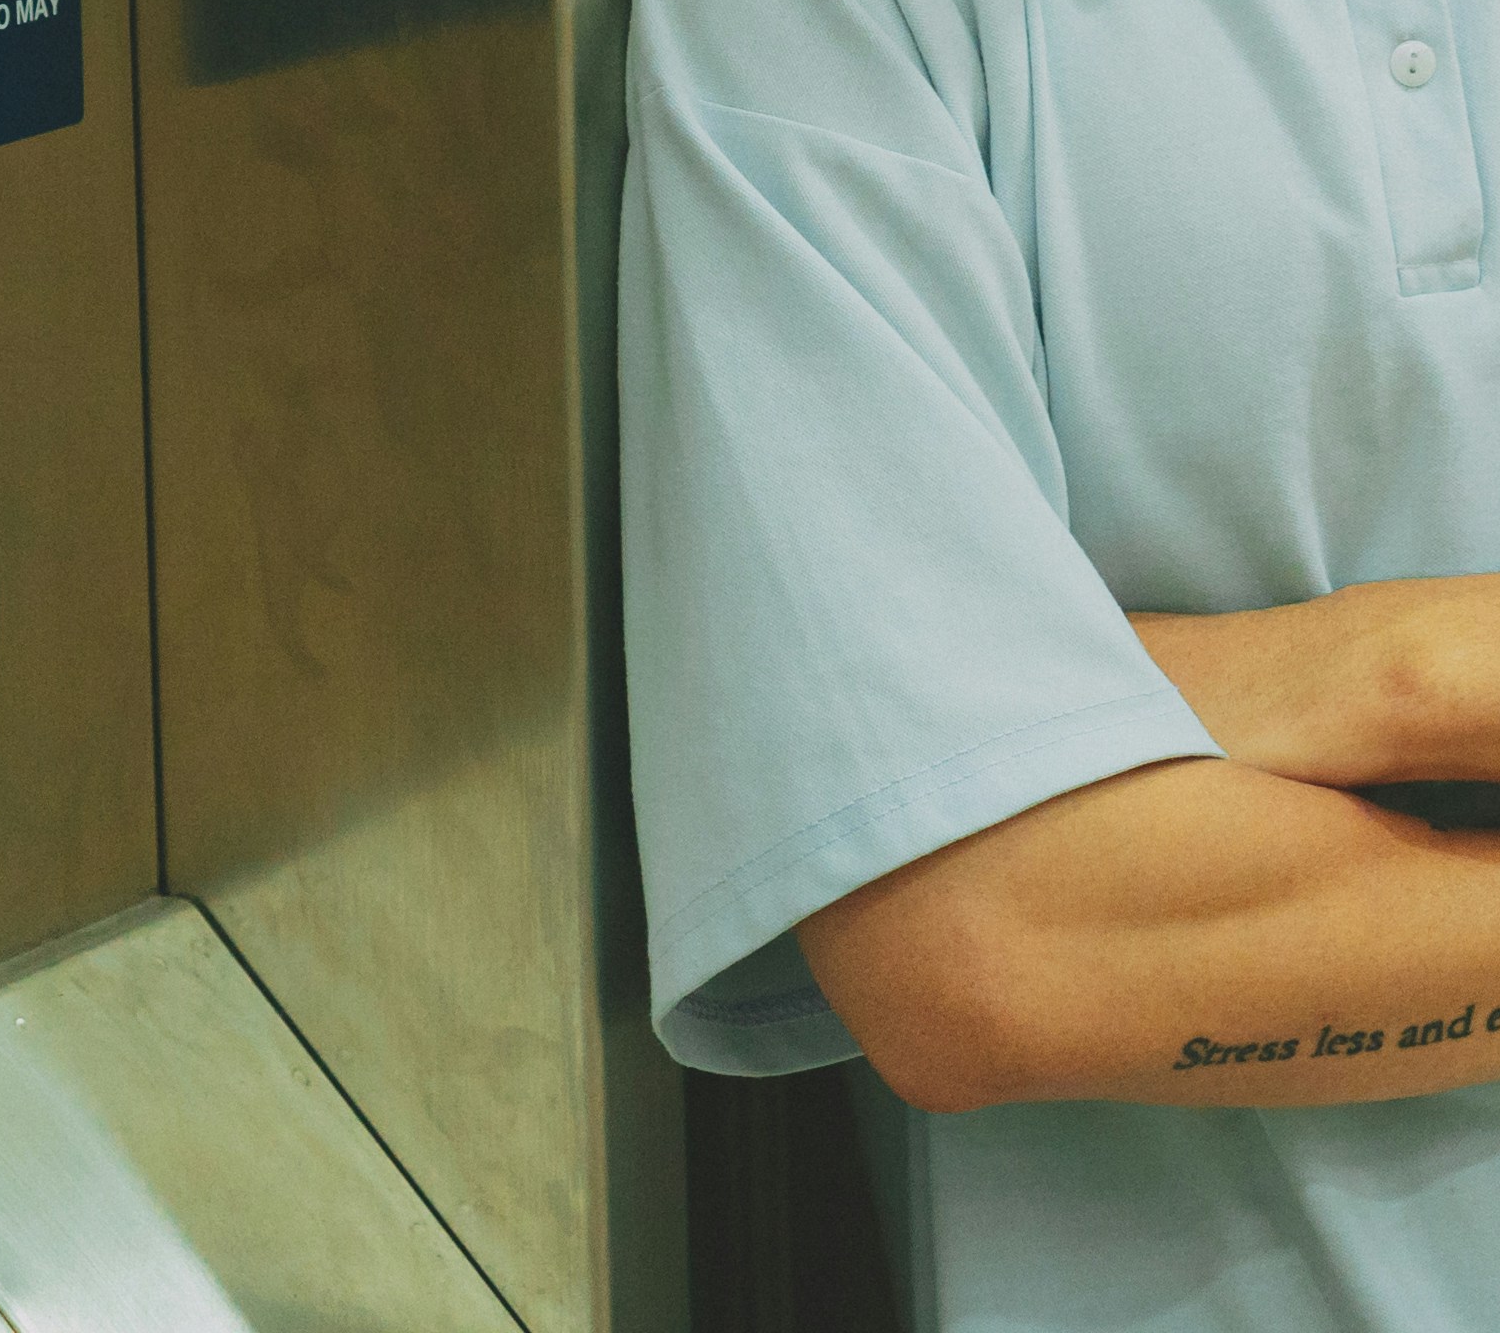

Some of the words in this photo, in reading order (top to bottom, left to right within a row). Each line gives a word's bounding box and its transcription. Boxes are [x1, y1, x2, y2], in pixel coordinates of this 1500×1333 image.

[1173, 1036, 1299, 1070] Stress
[1311, 1024, 1385, 1058] less
[1397, 1003, 1476, 1049] and
